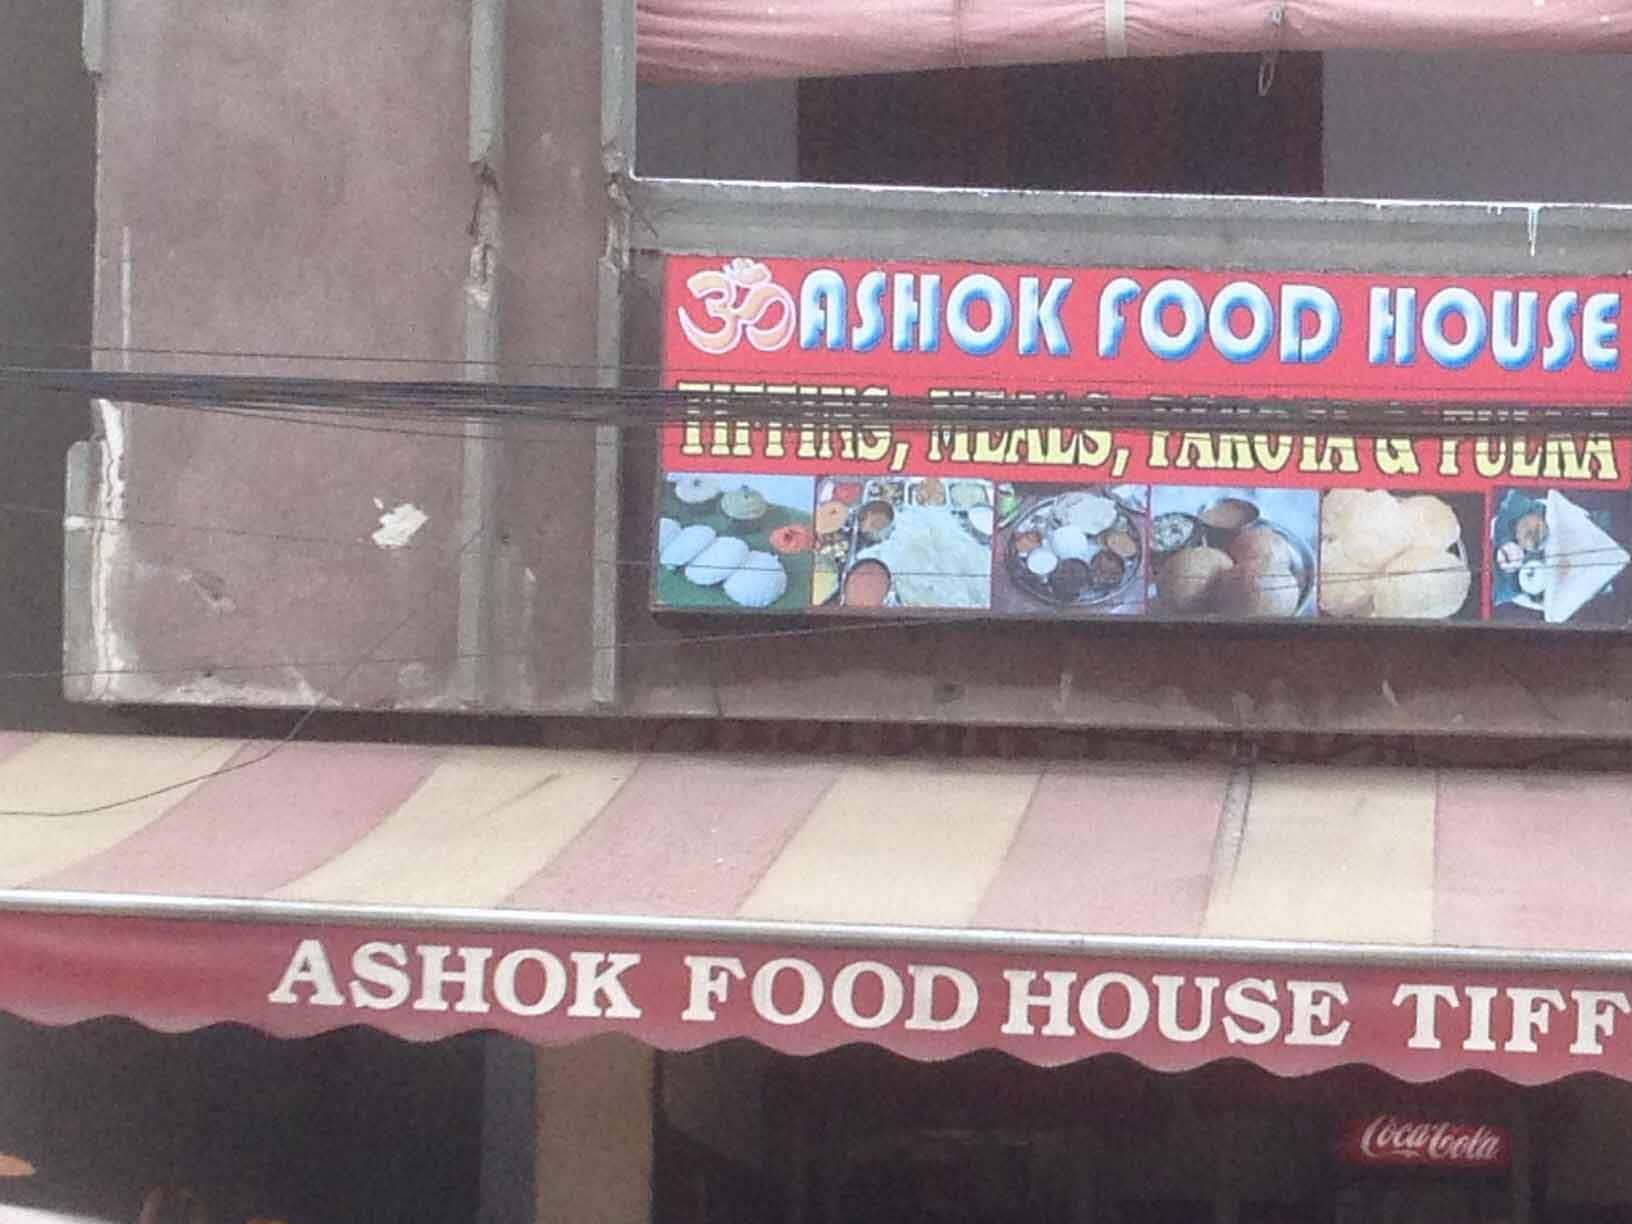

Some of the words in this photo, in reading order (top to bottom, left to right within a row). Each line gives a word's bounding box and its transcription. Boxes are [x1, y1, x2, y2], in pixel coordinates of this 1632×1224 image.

[800, 268, 1075, 358] ASHOK
[1097, 277, 1342, 364] FOOD
[1368, 286, 1621, 373] HOUSE
[266, 937, 643, 1022] ASHOK
[681, 954, 981, 1032] FOOD
[1000, 968, 1353, 1048] HOUSE
